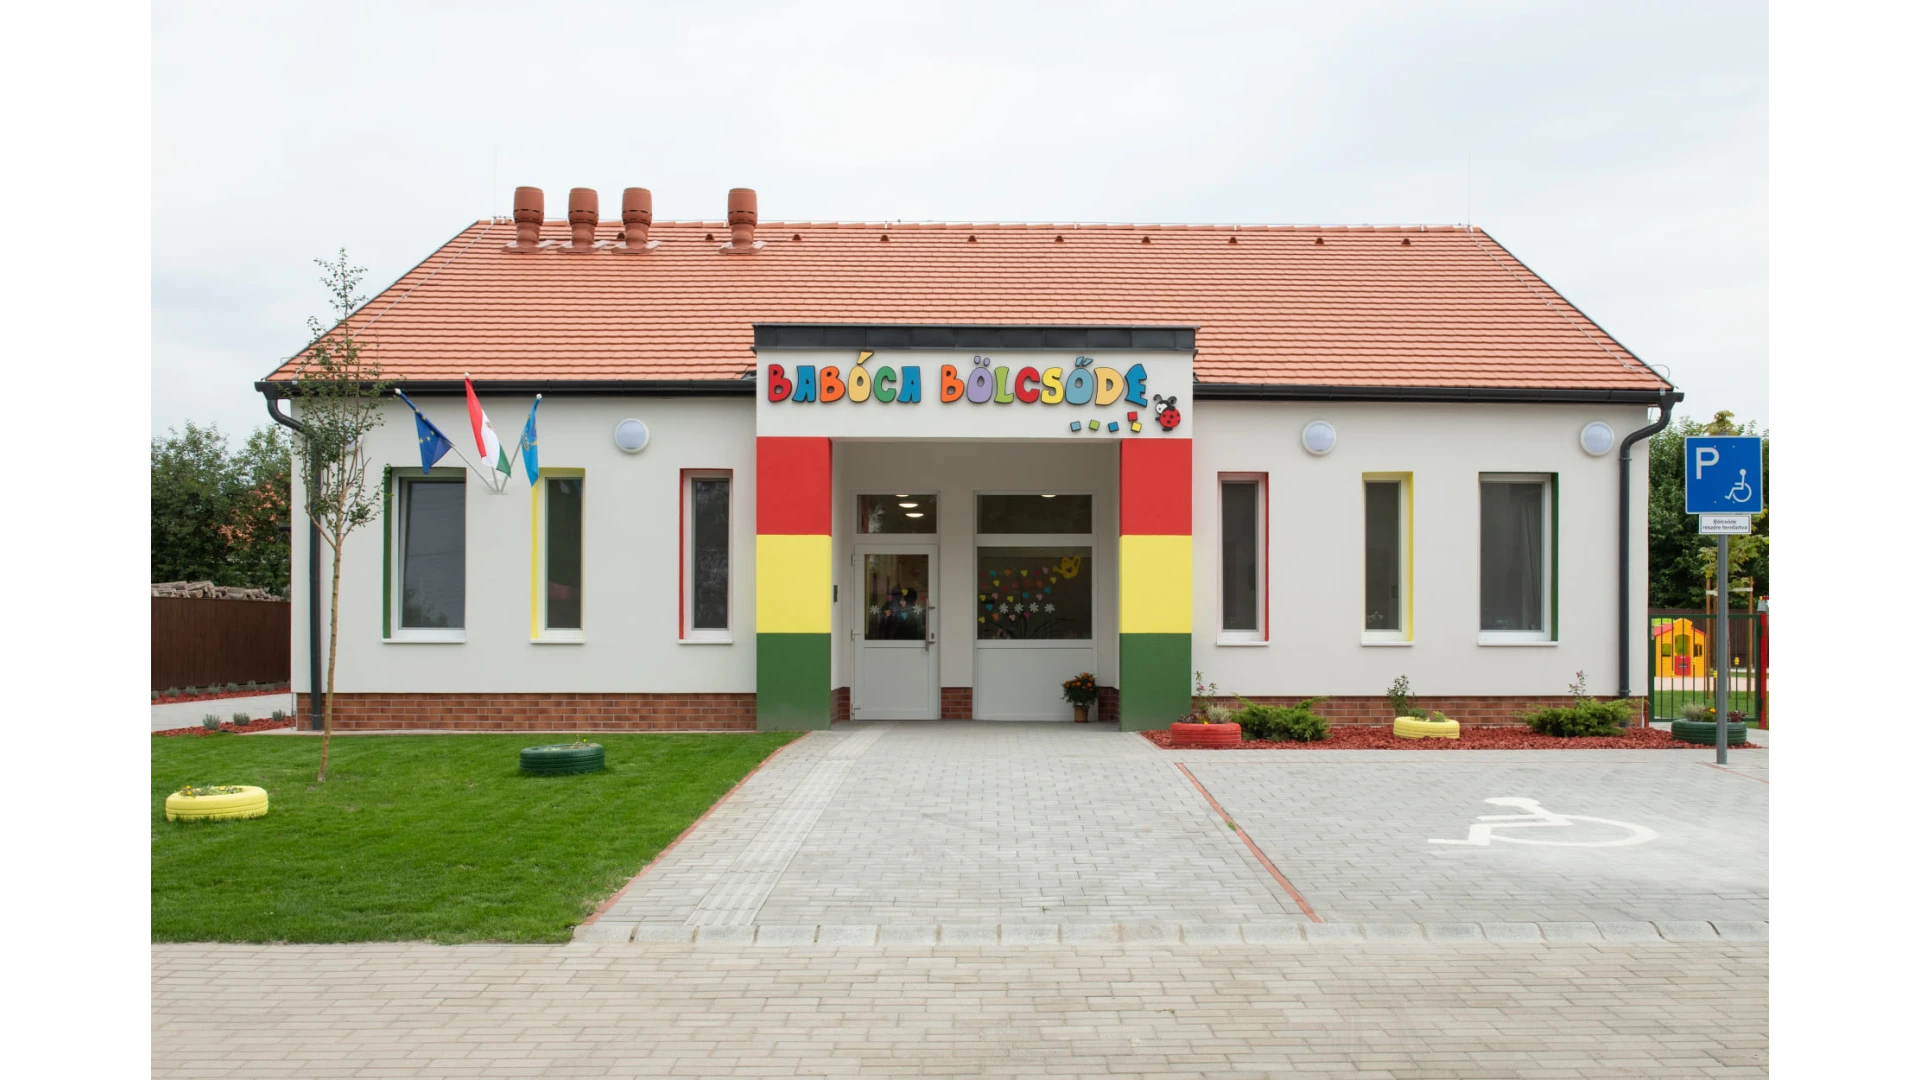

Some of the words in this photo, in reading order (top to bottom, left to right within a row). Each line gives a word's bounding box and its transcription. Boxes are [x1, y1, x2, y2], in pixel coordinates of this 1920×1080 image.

[768, 351, 921, 404] BABÓCA
[940, 355, 1148, 408] BÖLCSŐDE
[1696, 447, 1720, 480] P
